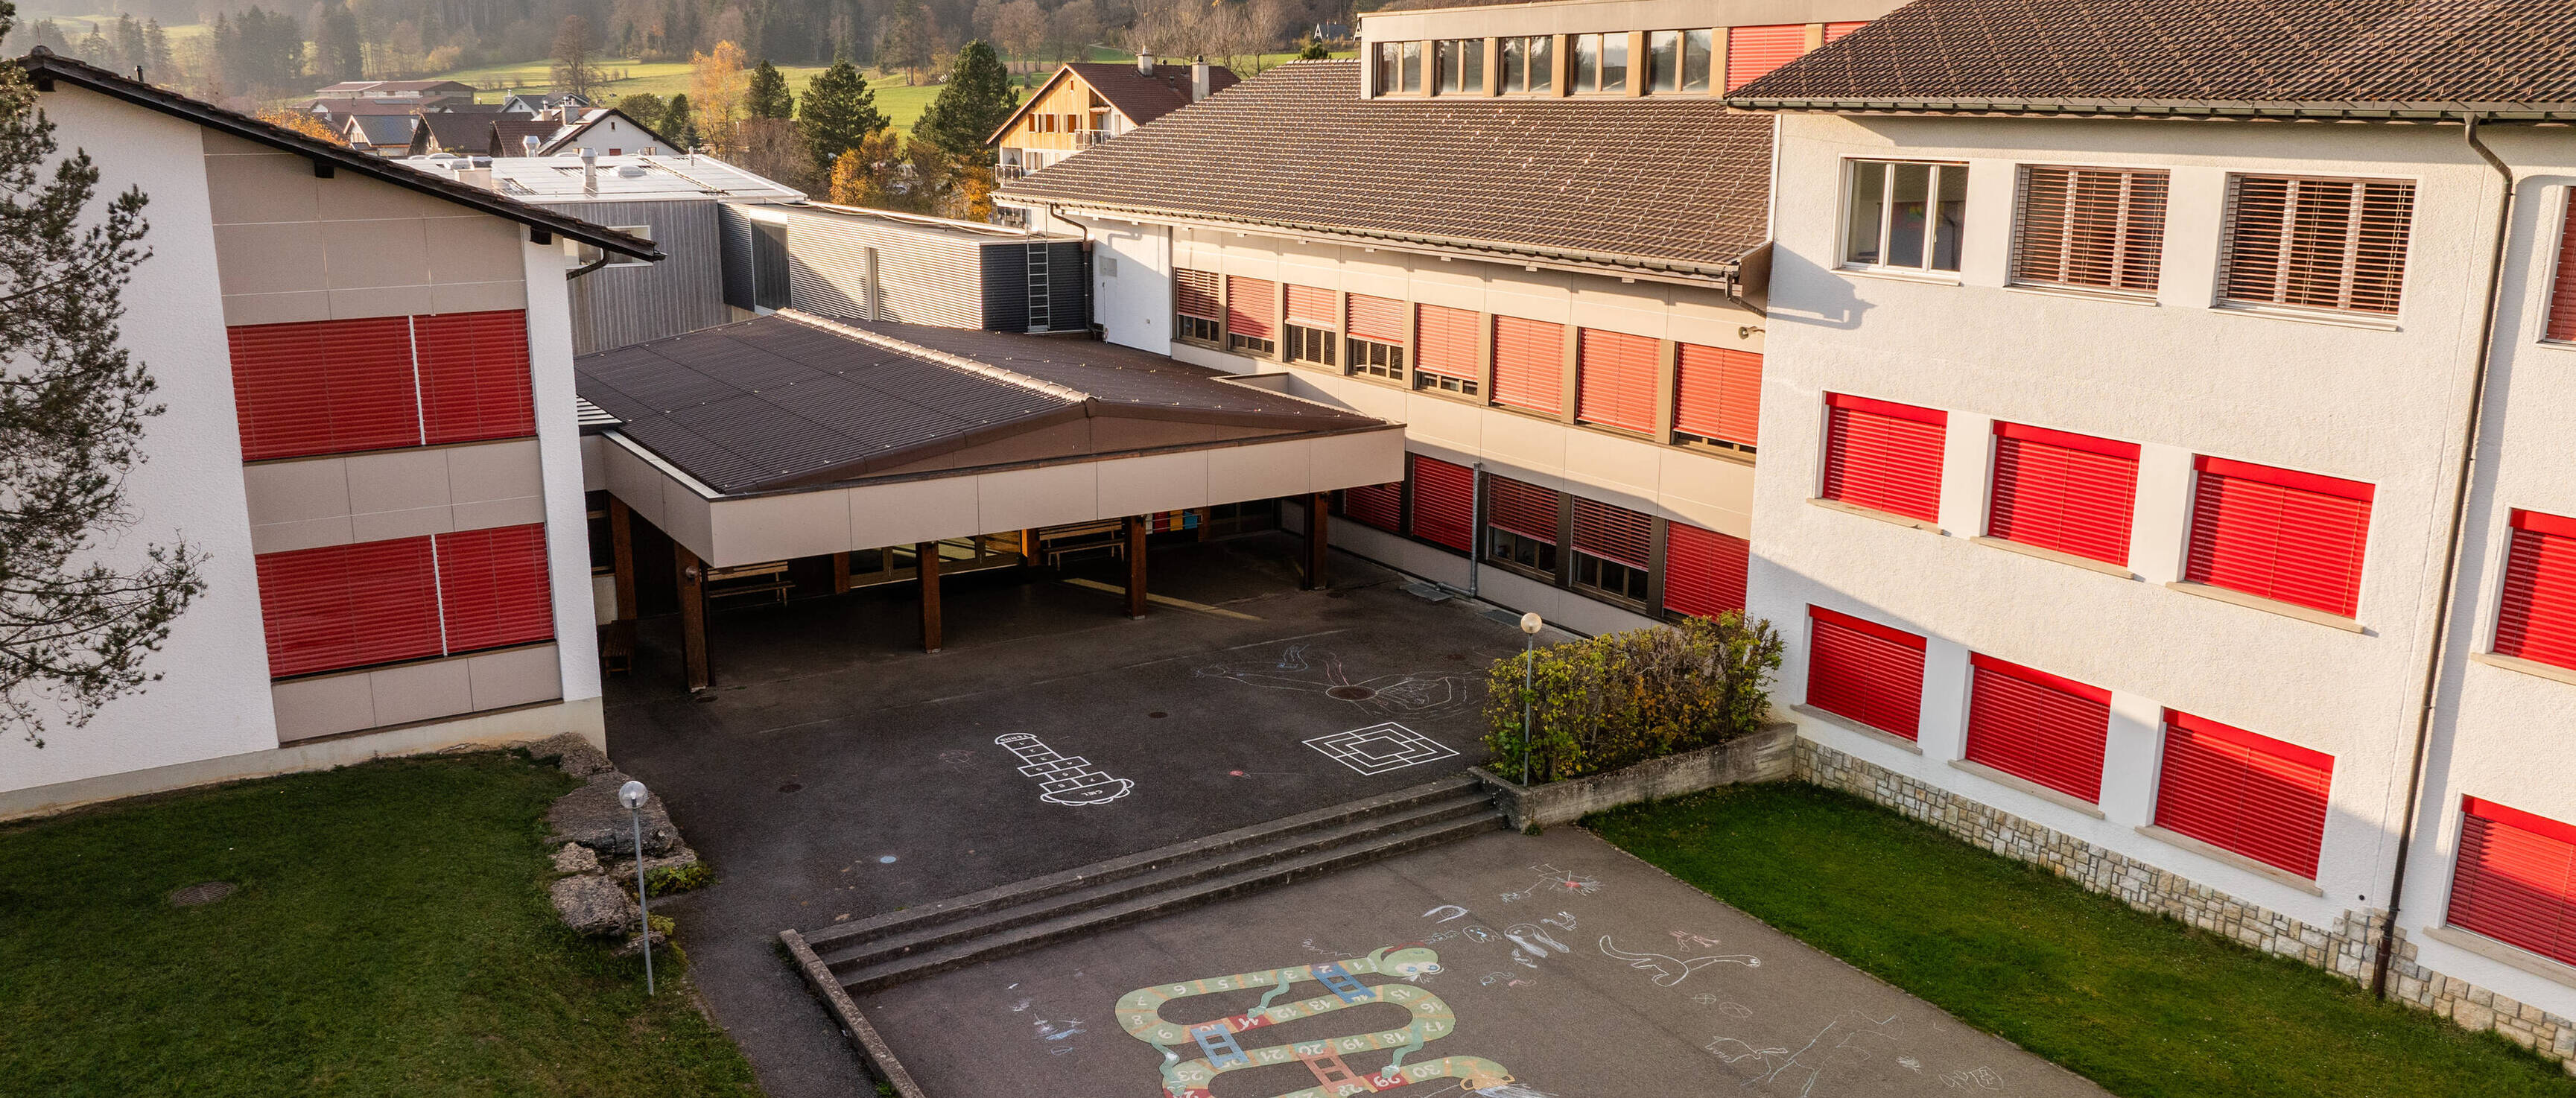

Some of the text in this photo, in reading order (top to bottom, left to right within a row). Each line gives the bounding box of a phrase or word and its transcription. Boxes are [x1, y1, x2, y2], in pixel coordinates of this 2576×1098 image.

[1318, 965, 1332, 974] 2
[1353, 962, 1362, 971] 1
[1253, 974, 1263, 984] 4
[1284, 970, 1297, 980] 3
[1173, 985, 1187, 995] 6
[1218, 980, 1229, 989] 5
[1390, 988, 1411, 1000] 15
[1134, 996, 1147, 1006] 7
[1309, 1000, 1330, 1011] 13
[1275, 1007, 1297, 1018] 12
[1420, 1001, 1443, 1013] 16
[1132, 1015, 1143, 1025] 8
[1423, 1021, 1444, 1032] 17
[1158, 1029, 1173, 1039] 9
[1383, 1032, 1406, 1043] 18
[1342, 1038, 1364, 1050] 19
[1260, 1049, 1284, 1061] 21
[1177, 1070, 1204, 1082] 23
[1412, 1064, 1441, 1078] 30
[1336, 1083, 1362, 1097] 28
